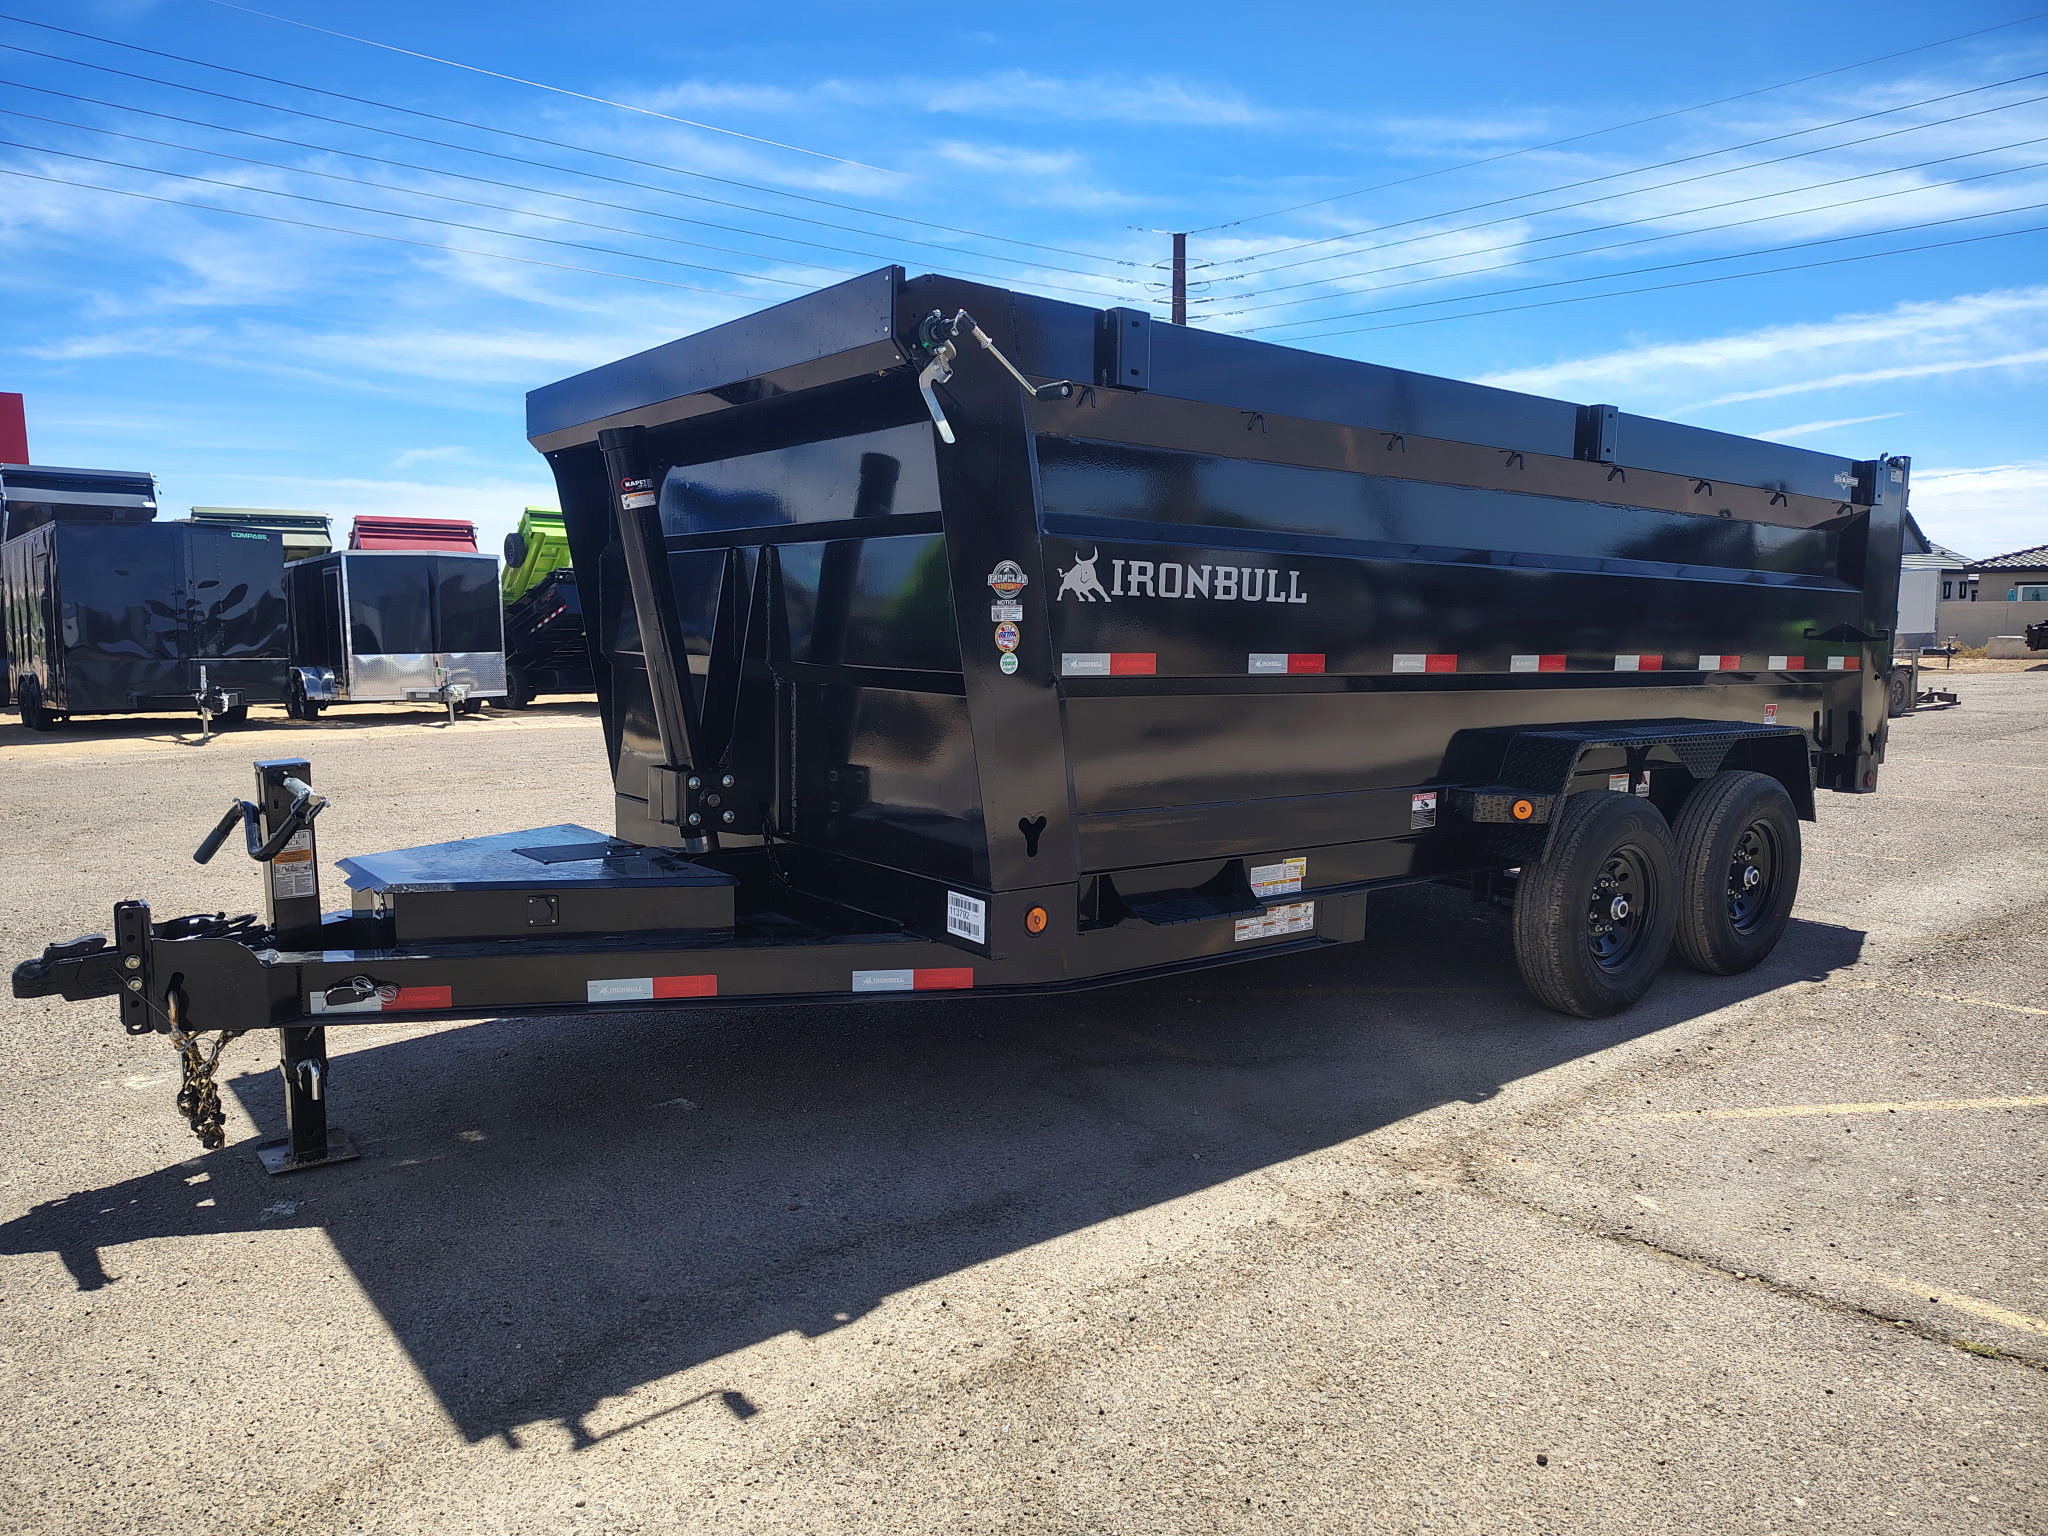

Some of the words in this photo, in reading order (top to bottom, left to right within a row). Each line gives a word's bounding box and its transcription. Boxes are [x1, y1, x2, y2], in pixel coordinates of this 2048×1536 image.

[231, 532, 267, 540] COMPASS
[1111, 559, 1307, 603] IRONBULL
[1654, 823, 1679, 879] RAMBLER
[950, 906, 970, 920] 113792
[609, 985, 643, 993] IRONBULL
